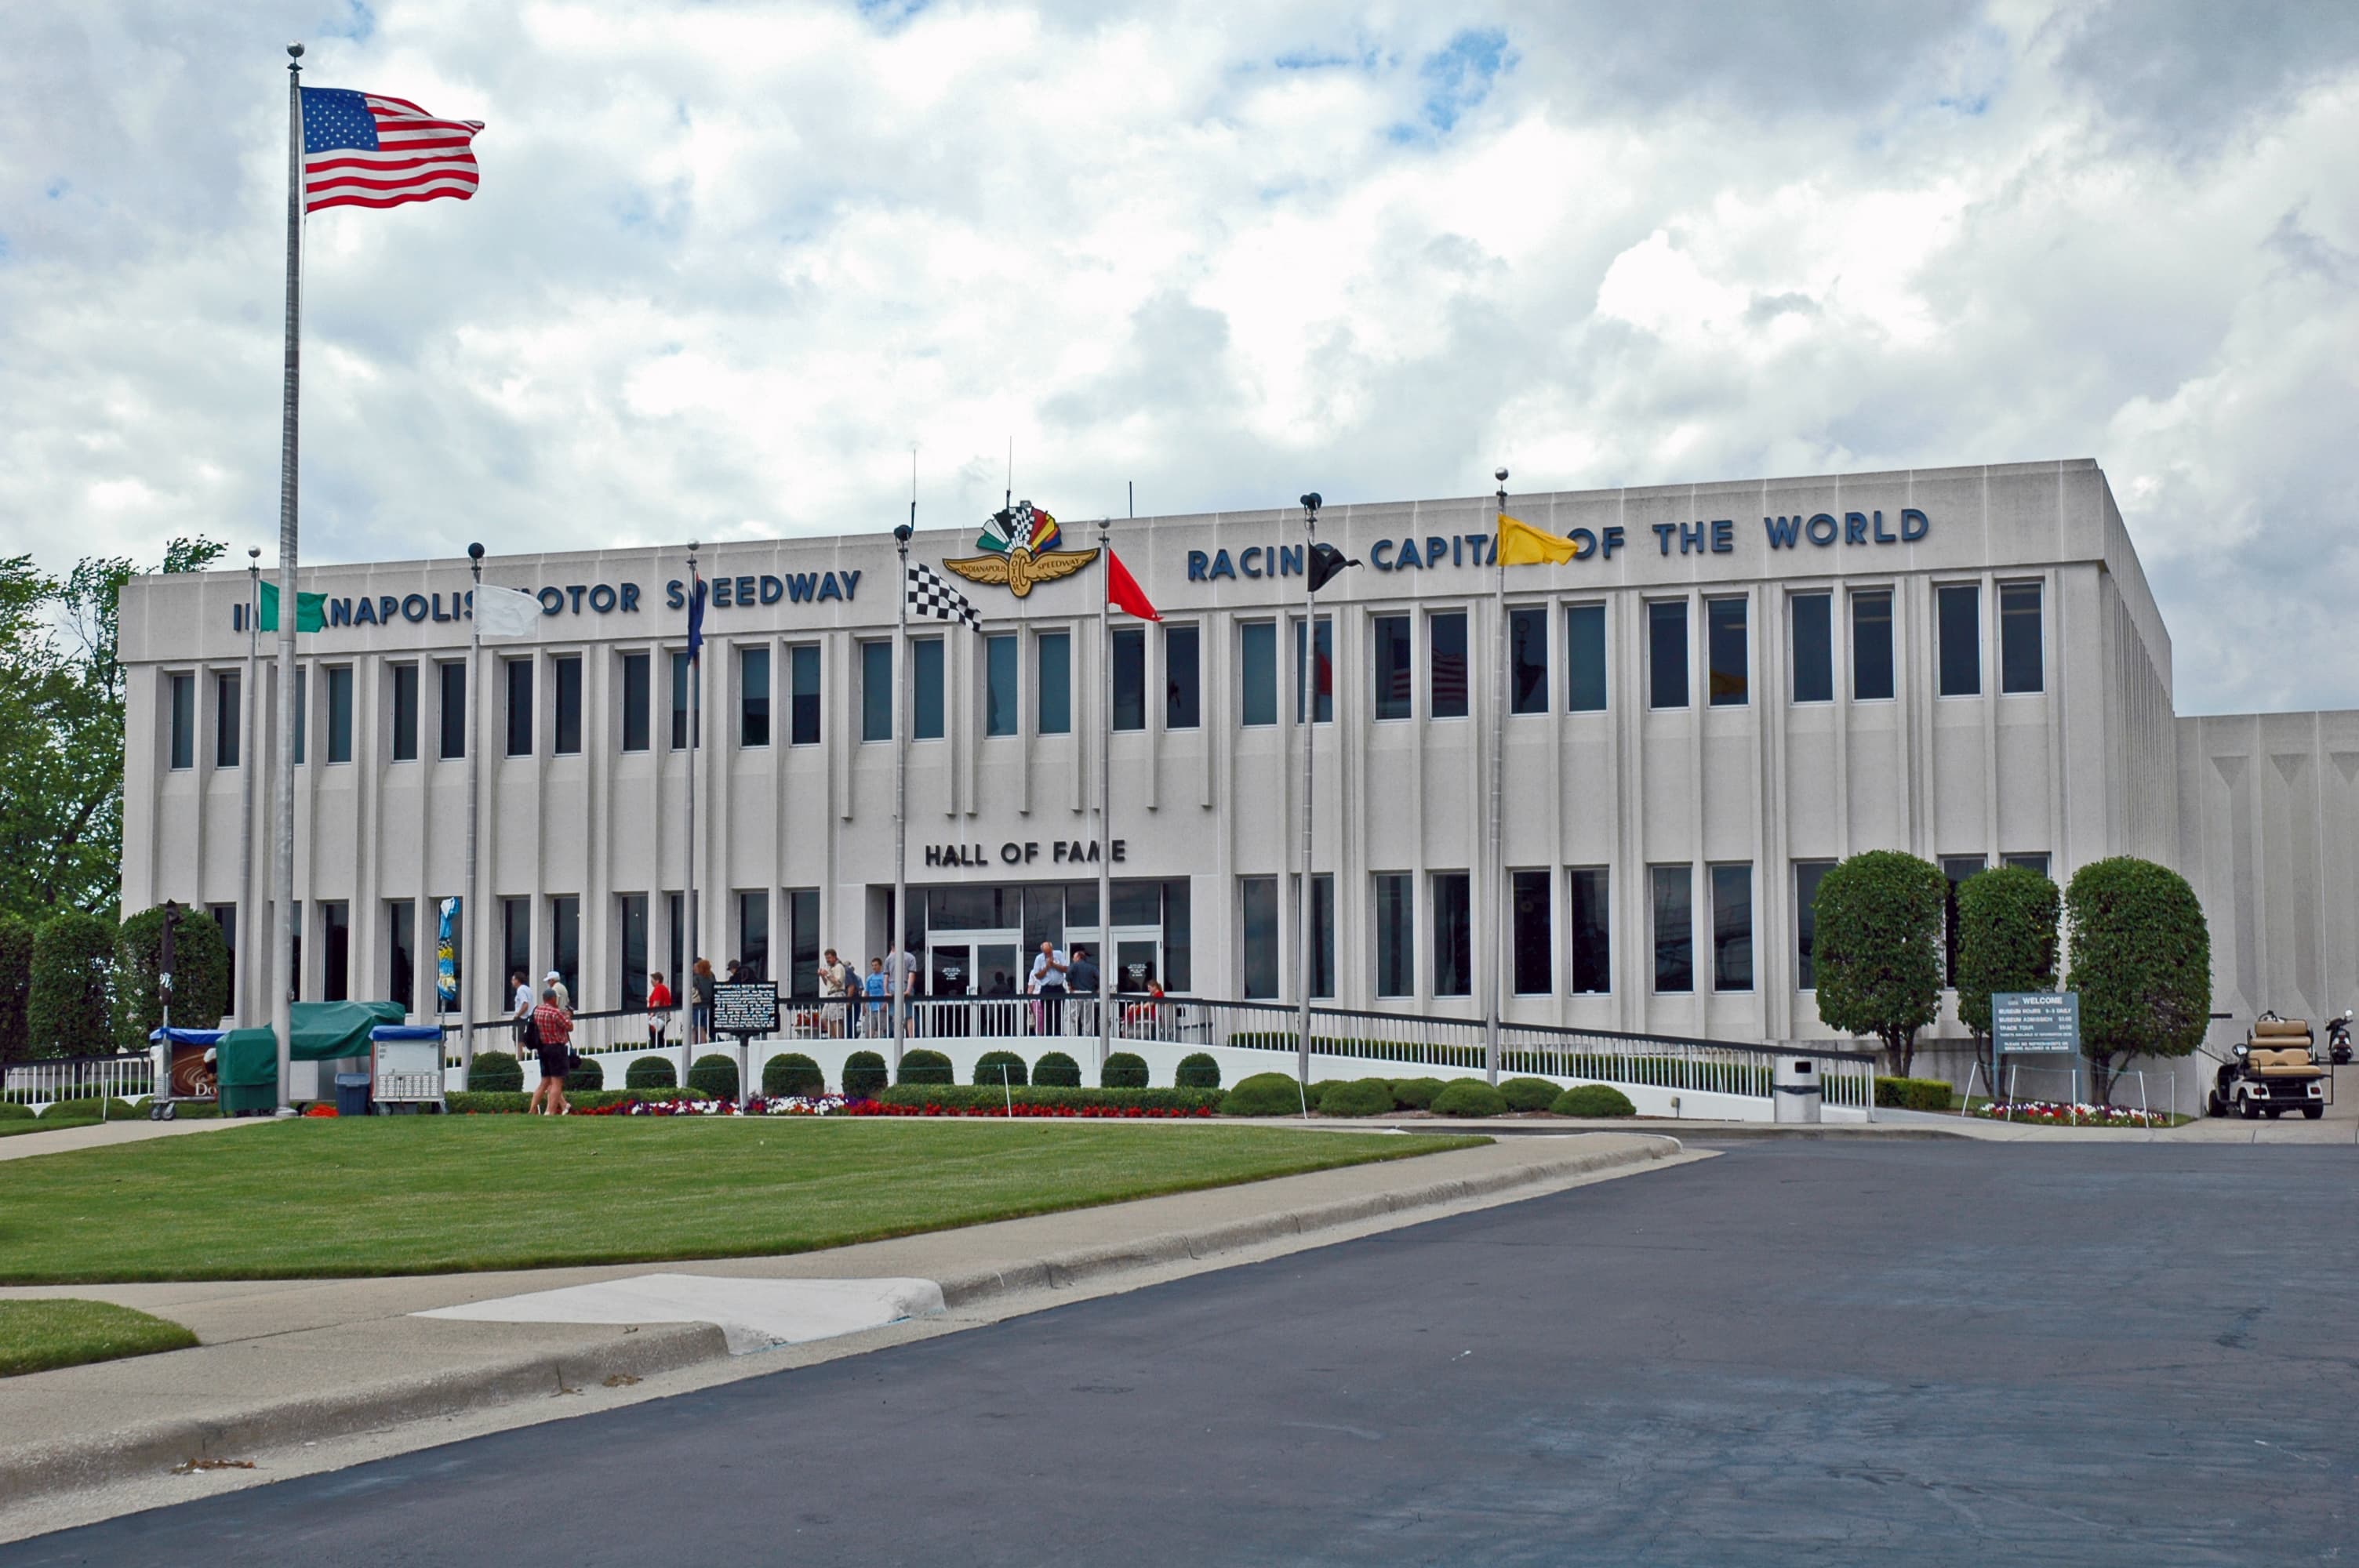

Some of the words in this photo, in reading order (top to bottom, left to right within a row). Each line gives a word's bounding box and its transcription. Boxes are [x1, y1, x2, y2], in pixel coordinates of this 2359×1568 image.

[1187, 543, 1333, 582] RACIN
[1566, 526, 1625, 560] OF
[1652, 520, 1734, 555] THE
[1764, 509, 1929, 548] WORLD
[961, 564, 1007, 573] INDIANAPOLIS
[1012, 554, 1020, 590] MOTOR
[1037, 557, 1081, 571] SPEEDWAY
[511, 583, 641, 615] OTOR
[925, 844, 988, 866] HALL
[1000, 842, 1038, 864] OF
